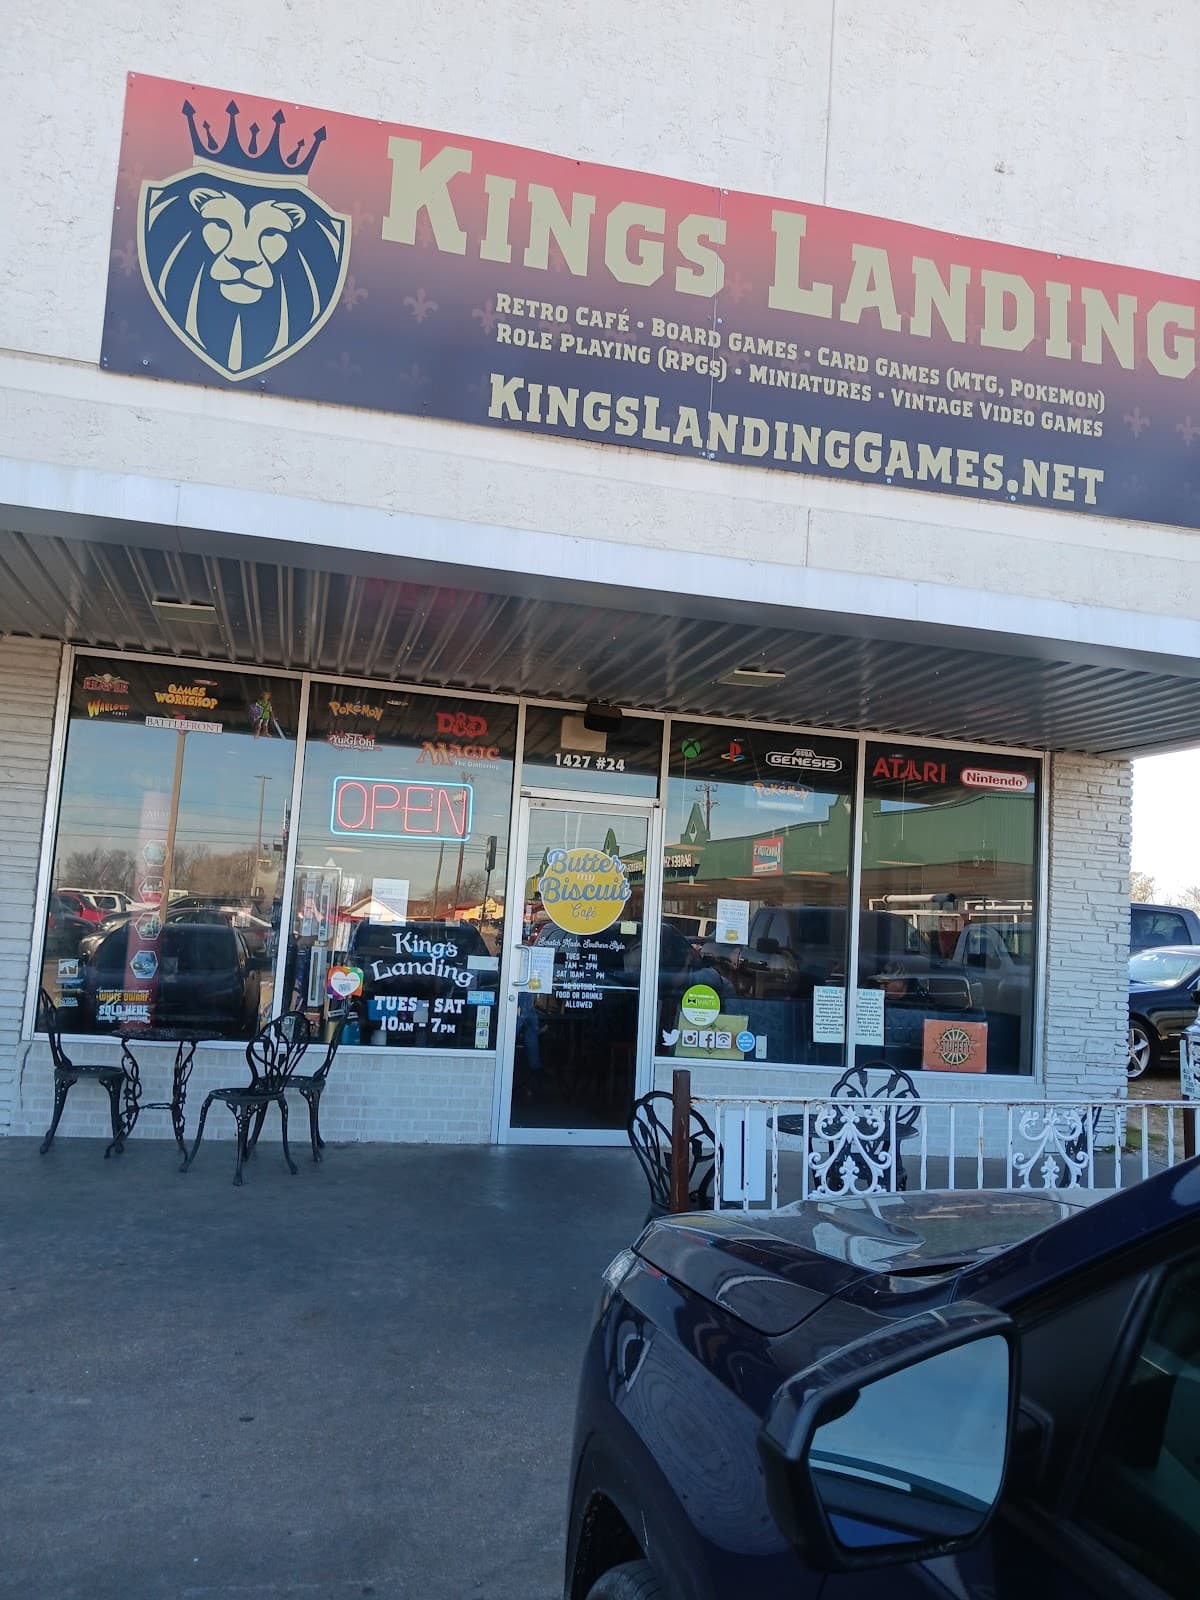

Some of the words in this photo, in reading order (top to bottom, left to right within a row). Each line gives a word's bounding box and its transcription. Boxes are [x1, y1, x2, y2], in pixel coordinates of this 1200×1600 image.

[381, 135, 727, 298] KINGS
[767, 209, 1196, 380] LANDING
[495, 292, 568, 324] RETRO
[575, 306, 630, 332] CAFÉ
[651, 317, 722, 349] BOARD
[728, 332, 798, 362] GAMES
[817, 347, 869, 373] CARD
[875, 358, 940, 385] GAMES
[945, 366, 1005, 398] (MTG,
[1010, 378, 1106, 414] POKEMON)
[496, 322, 553, 351] ROLE
[559, 334, 651, 366] PLAYING
[657, 346, 728, 383] (RPGS)
[749, 364, 872, 403] MINIATURES
[891, 388, 973, 419] VINTAGE
[979, 403, 1035, 428] VIDEO
[1041, 411, 1103, 438] GAMES
[487, 373, 1105, 505] KINGSLANDINGGAMES.NET
[154, 692, 219, 710] WORKSHOP
[167, 683, 207, 698] GAMES
[146, 717, 223, 733] BATTLEFRONT
[436, 711, 488, 738] D&D
[415, 741, 500, 767] MAGIC
[554, 752, 591, 769] 1427
[595, 756, 626, 773] #24
[770, 755, 837, 769] GENESIS
[872, 756, 946, 784] ATARI
[966, 771, 1023, 788] Nintendo
[337, 781, 468, 836] OPEN
[547, 848, 626, 874] Butter
[576, 873, 596, 883] my
[539, 876, 632, 904] Biscuit
[391, 930, 459, 959] King's
[565, 952, 581, 961] TUES
[370, 957, 475, 988] Landing
[374, 995, 418, 1012] TUES
[433, 998, 466, 1015] SAT
[555, 990, 571, 999] FOOD
[571, 991, 580, 999] OR
[581, 991, 603, 1001] DRINKS
[565, 1000, 593, 1009] ALLOWED
[98, 1004, 122, 1016] SOLD
[125, 1004, 149, 1017] HERE
[380, 1015, 414, 1033] 10AM
[430, 1017, 456, 1034] 7PM
